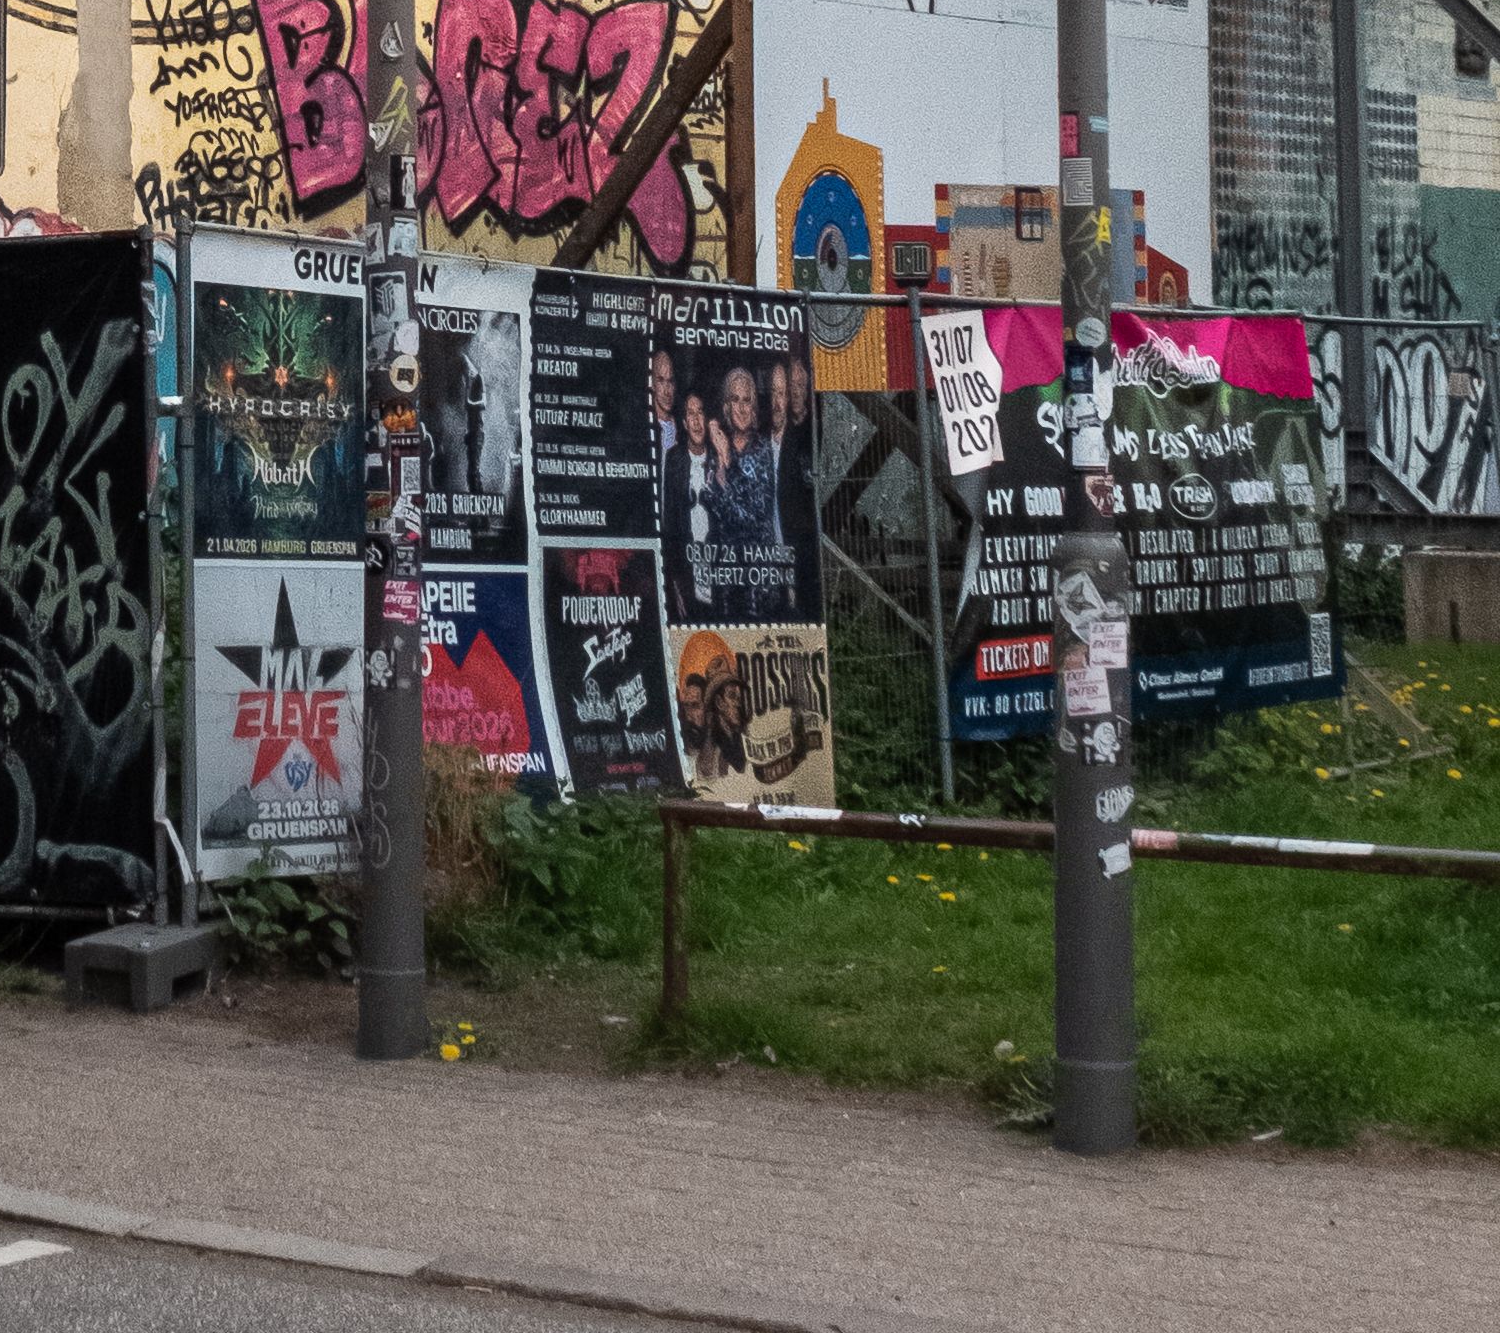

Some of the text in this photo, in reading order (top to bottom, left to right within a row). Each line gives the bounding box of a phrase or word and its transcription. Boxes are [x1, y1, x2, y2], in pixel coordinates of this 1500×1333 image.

[592, 292, 646, 313] HIGHLIGHTS
[429, 310, 478, 334] CIRCLES
[675, 326, 790, 353] germany 2026
[930, 325, 974, 369] 31/07
[537, 358, 578, 378] KREATOR
[940, 369, 998, 415] 01/08
[208, 396, 352, 419] HYPOCRISY
[535, 409, 605, 429] FUTURE PALACE
[537, 458, 650, 480] DIMMU BORGIR & BEHEMOTH
[452, 493, 504, 517] GRUENSPAN
[1173, 485, 1214, 505] TRASH
[540, 508, 607, 527] GLORYHAMMER
[207, 536, 357, 556] 21.04.2026 HAMBURG GRUENSPAN
[430, 527, 472, 551] HAMBURG
[685, 544, 737, 565] 08.07.26
[385, 579, 409, 591] EXIT
[749, 567, 783, 587] OPEN
[562, 595, 643, 628] POWERWOLF
[991, 597, 1031, 626] ABOUT
[981, 640, 1049, 674] TICKETS ON
